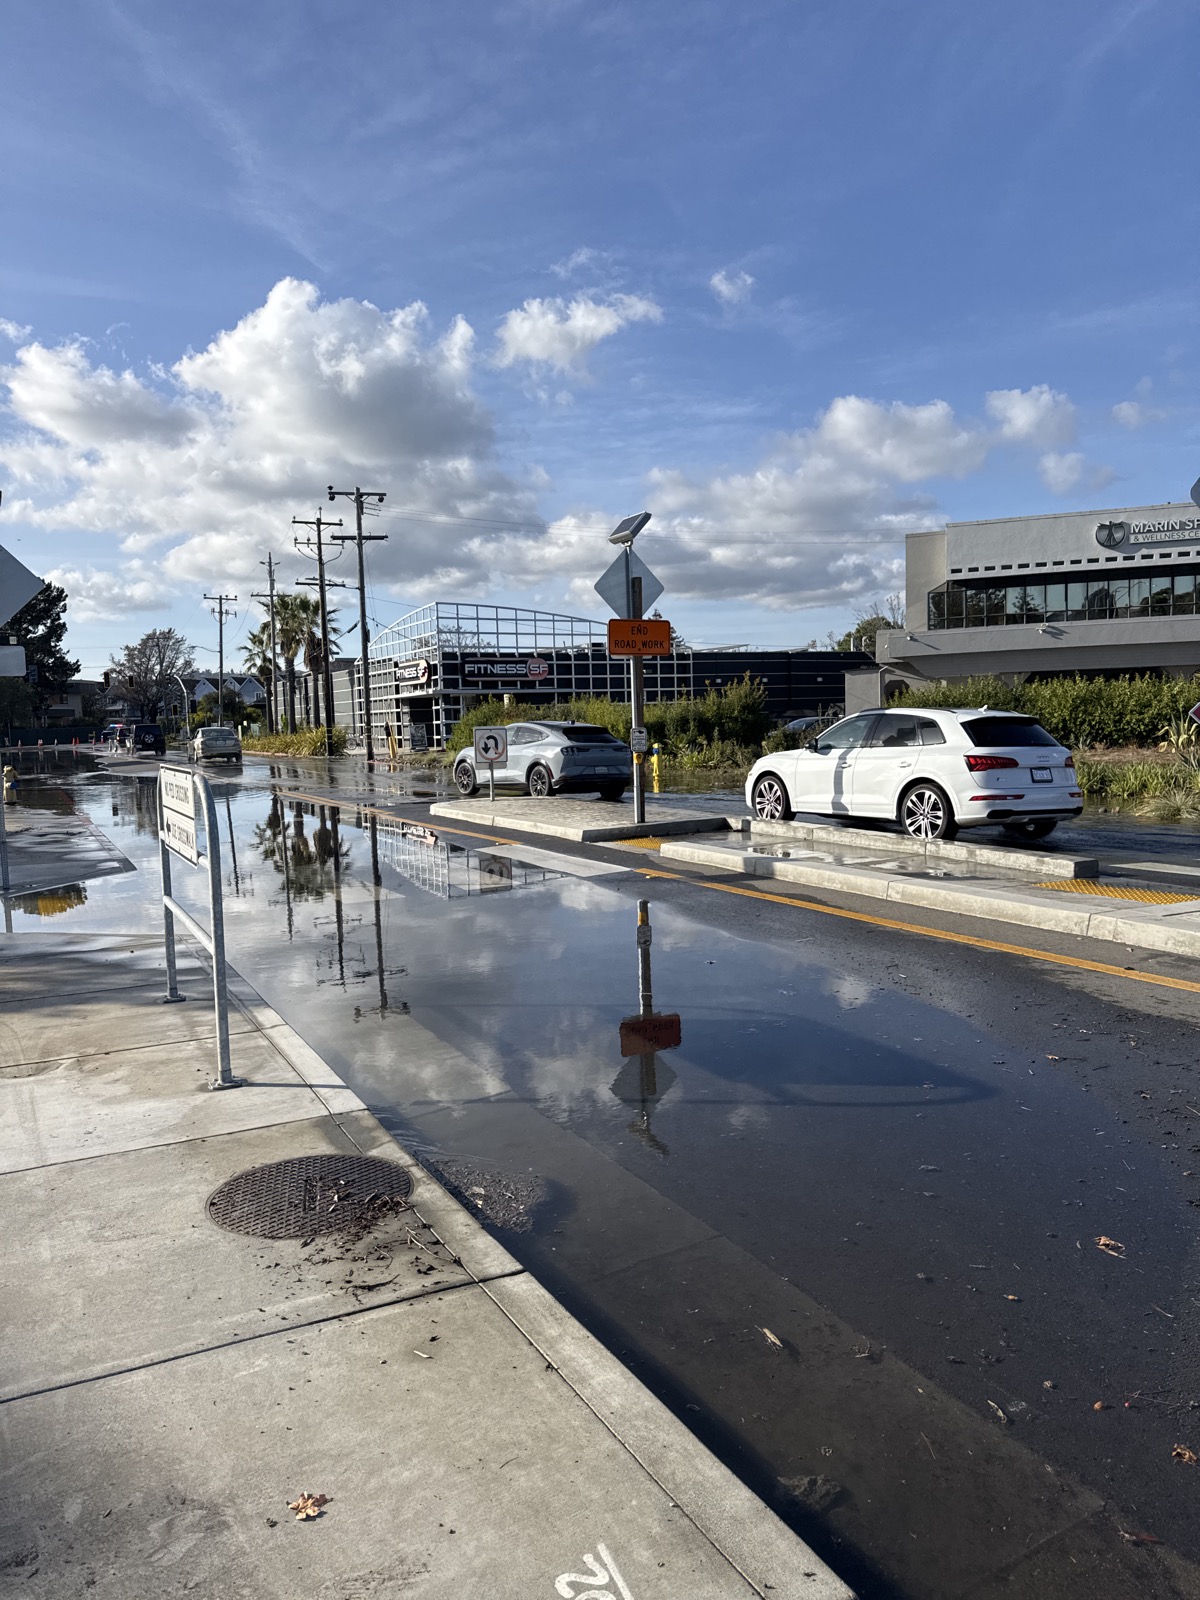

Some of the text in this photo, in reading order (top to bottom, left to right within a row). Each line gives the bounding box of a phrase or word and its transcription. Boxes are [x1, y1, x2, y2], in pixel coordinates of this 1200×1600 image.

[1131, 520, 1180, 533] MARIN
[1142, 532, 1186, 541] WELLNESS
[631, 627, 649, 636] END
[614, 640, 665, 649] ROAD WORK
[464, 664, 548, 674] FITNESS SF
